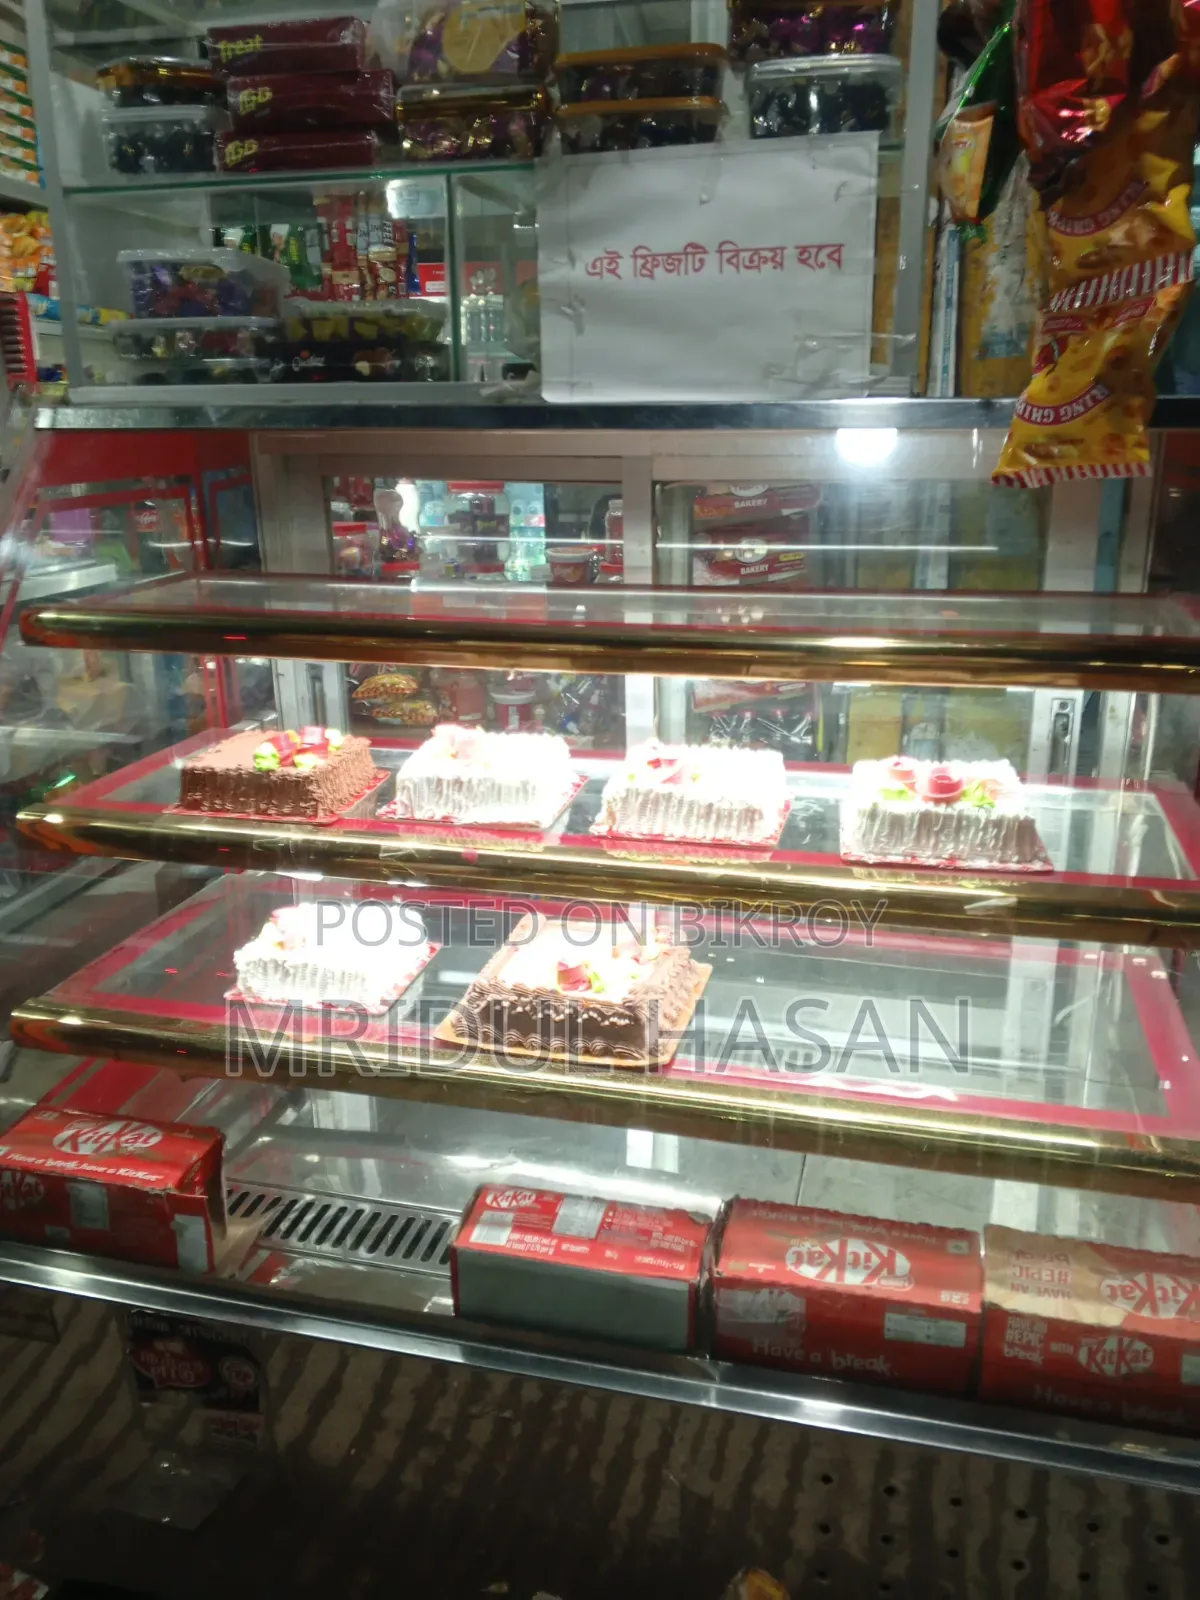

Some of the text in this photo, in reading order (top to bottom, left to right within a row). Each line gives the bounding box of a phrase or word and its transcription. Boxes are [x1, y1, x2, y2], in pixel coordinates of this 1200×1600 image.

[585, 240, 845, 280] এই ফ্রিজটি বিক্রয় হবে
[1015, 383, 1111, 424] RING CHIP
[734, 498, 768, 509] BAKERY
[740, 564, 769, 575] BAKERY
[56, 1119, 163, 1155] KitKat
[788, 1239, 900, 1285] KitKat
[1009, 1282, 1031, 1296] AN
[752, 1336, 804, 1362] Have
[808, 1352, 822, 1364] a
[1084, 1337, 1151, 1376] KitKat
